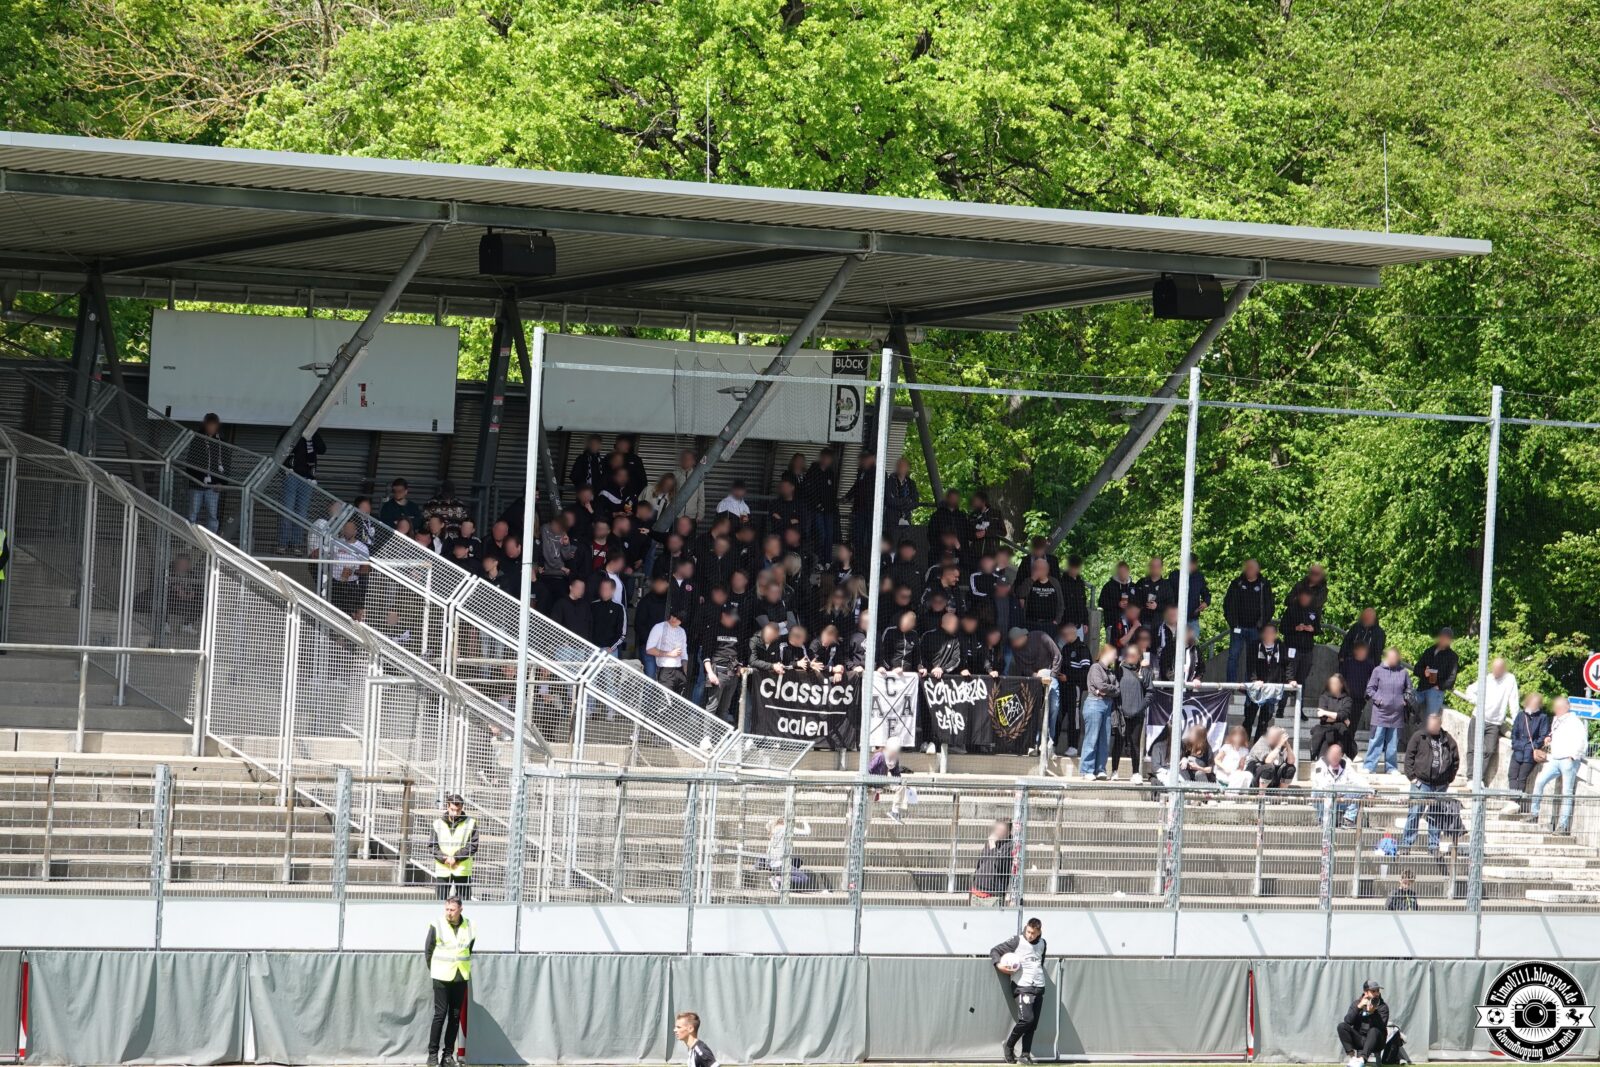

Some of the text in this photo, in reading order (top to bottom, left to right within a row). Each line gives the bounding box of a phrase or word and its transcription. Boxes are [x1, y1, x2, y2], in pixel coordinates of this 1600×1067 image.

[835, 358, 864, 369] BLOCK
[834, 384, 861, 432] D
[759, 674, 854, 706] classics
[884, 676, 897, 696] C
[871, 694, 914, 718] A A
[777, 716, 829, 737] aalen
